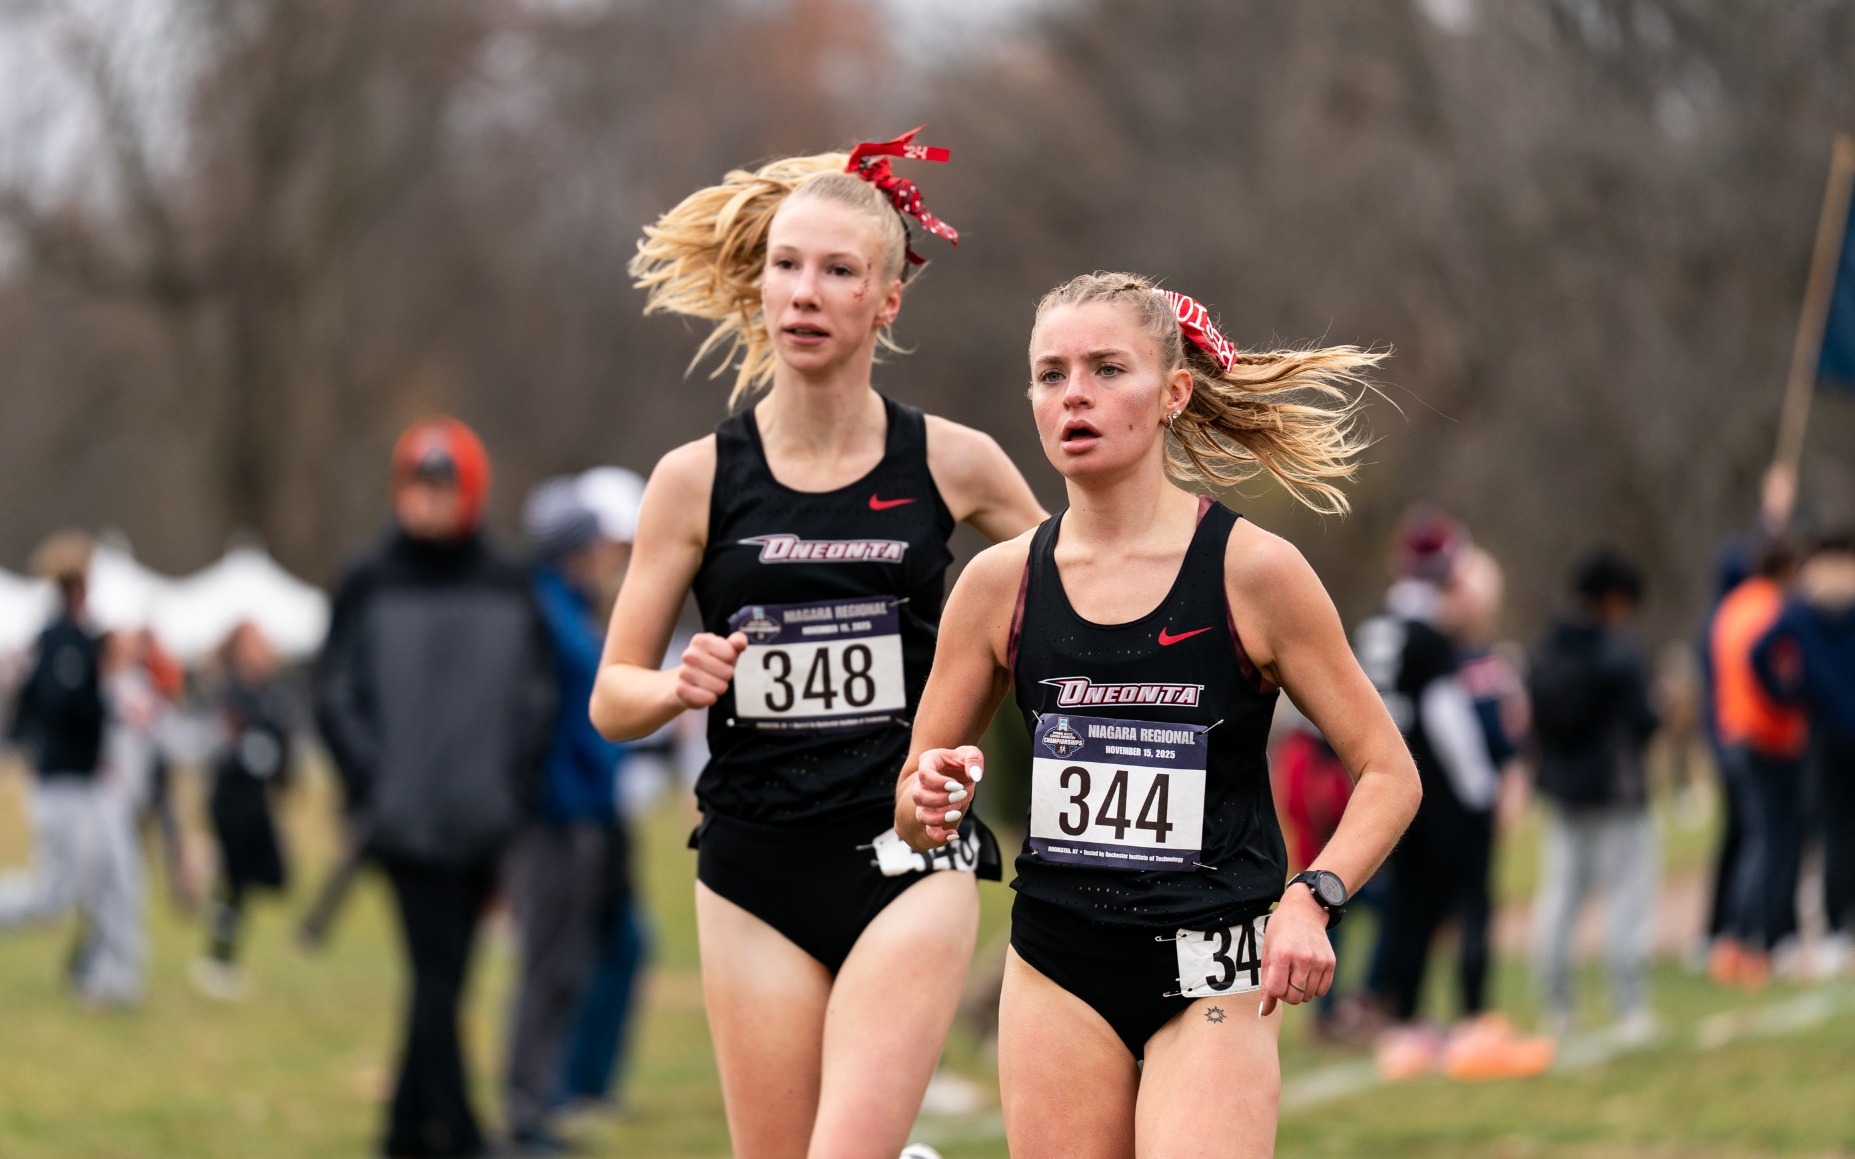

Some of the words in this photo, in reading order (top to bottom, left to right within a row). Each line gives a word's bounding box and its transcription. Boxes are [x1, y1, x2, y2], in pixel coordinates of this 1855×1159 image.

[903, 145, 928, 159] 24
[754, 535, 903, 562] ONEONTA
[763, 644, 875, 712] 348
[1050, 677, 1199, 707] ONEONTA
[1043, 737, 1083, 746] CHAMPIONSHIPS
[1088, 725, 1137, 741] NIAGARA
[1140, 728, 1195, 745] REGIONAL
[1105, 745, 1141, 756] NOVEMBER
[1143, 748, 1153, 758] 15,
[1155, 749, 1176, 759] 2025
[1059, 766, 1173, 843] 344
[1083, 849, 1098, 857] Hosted
[1105, 851, 1128, 859] Rochester
[1129, 853, 1148, 861] Institute
[1156, 856, 1184, 864] Technology
[1204, 916, 1271, 991] 34
